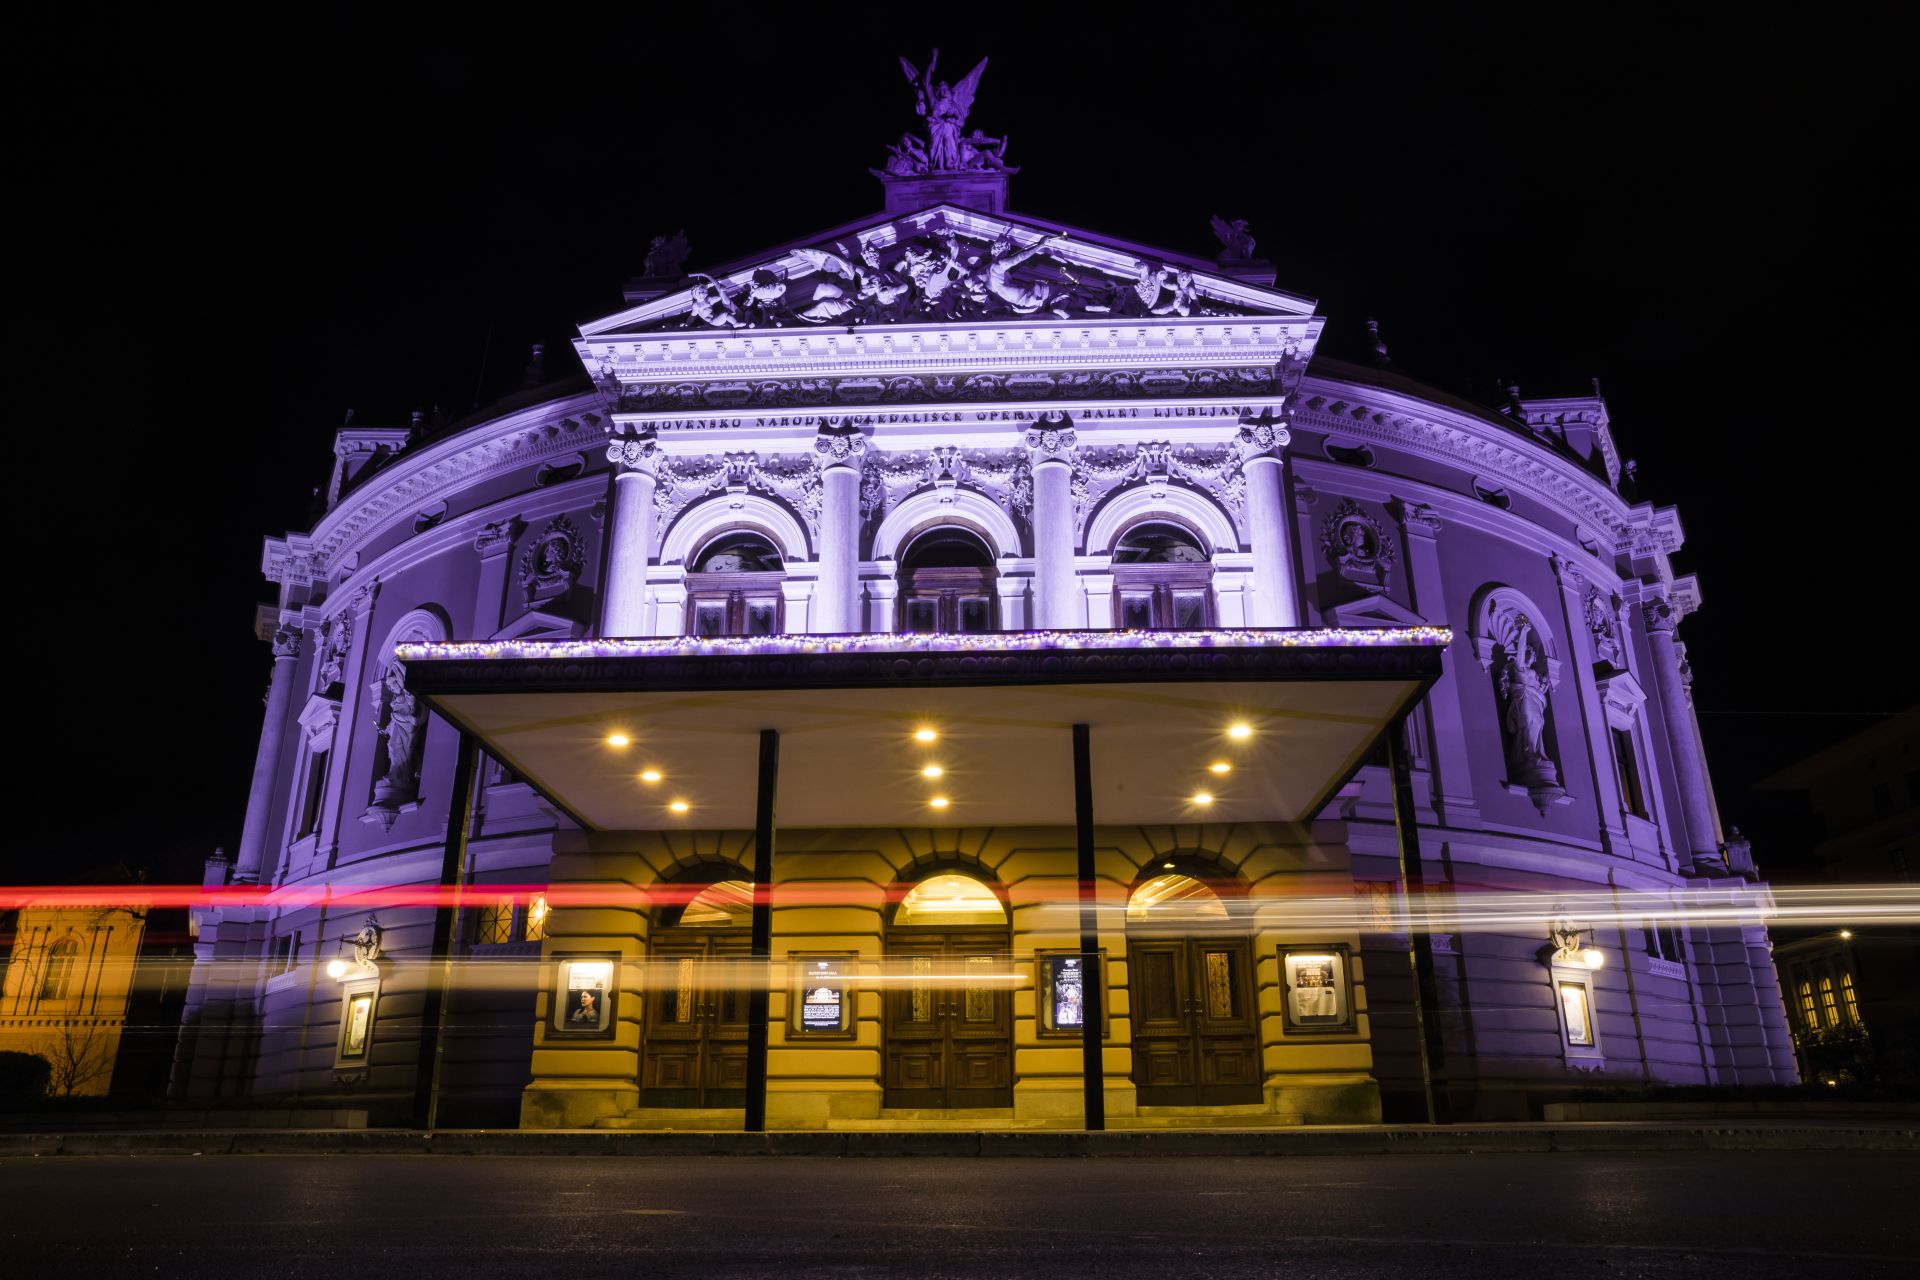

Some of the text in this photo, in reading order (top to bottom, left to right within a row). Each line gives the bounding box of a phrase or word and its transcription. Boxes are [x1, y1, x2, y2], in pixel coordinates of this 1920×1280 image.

[641, 418, 742, 431] SLOVENSKO
[976, 409, 1034, 421] OPERA
[1082, 407, 1139, 419] BALET
[1152, 405, 1254, 418] LJUBLJANA
